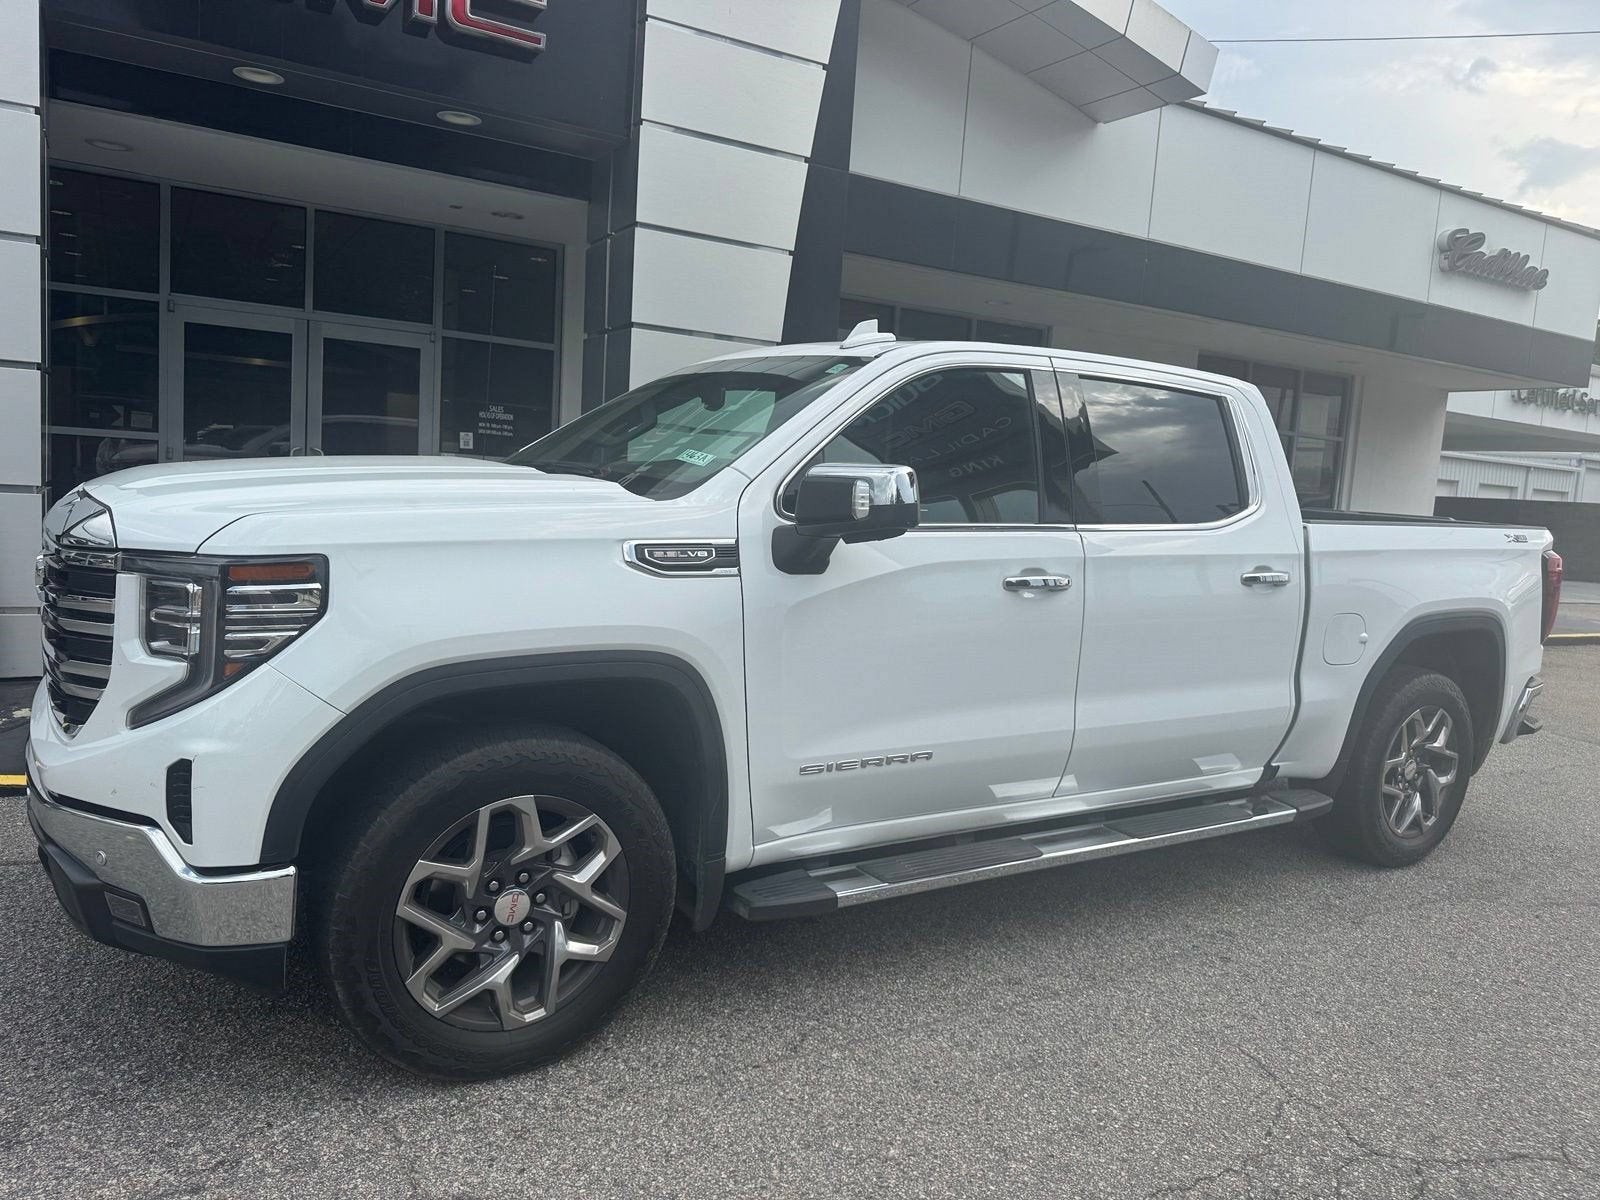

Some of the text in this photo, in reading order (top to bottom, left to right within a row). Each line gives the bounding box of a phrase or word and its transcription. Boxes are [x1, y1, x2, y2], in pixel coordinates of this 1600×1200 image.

[1437, 228, 1549, 290] Cadillac
[799, 751, 933, 775] SIERRA
[506, 892, 520, 923] GMC
